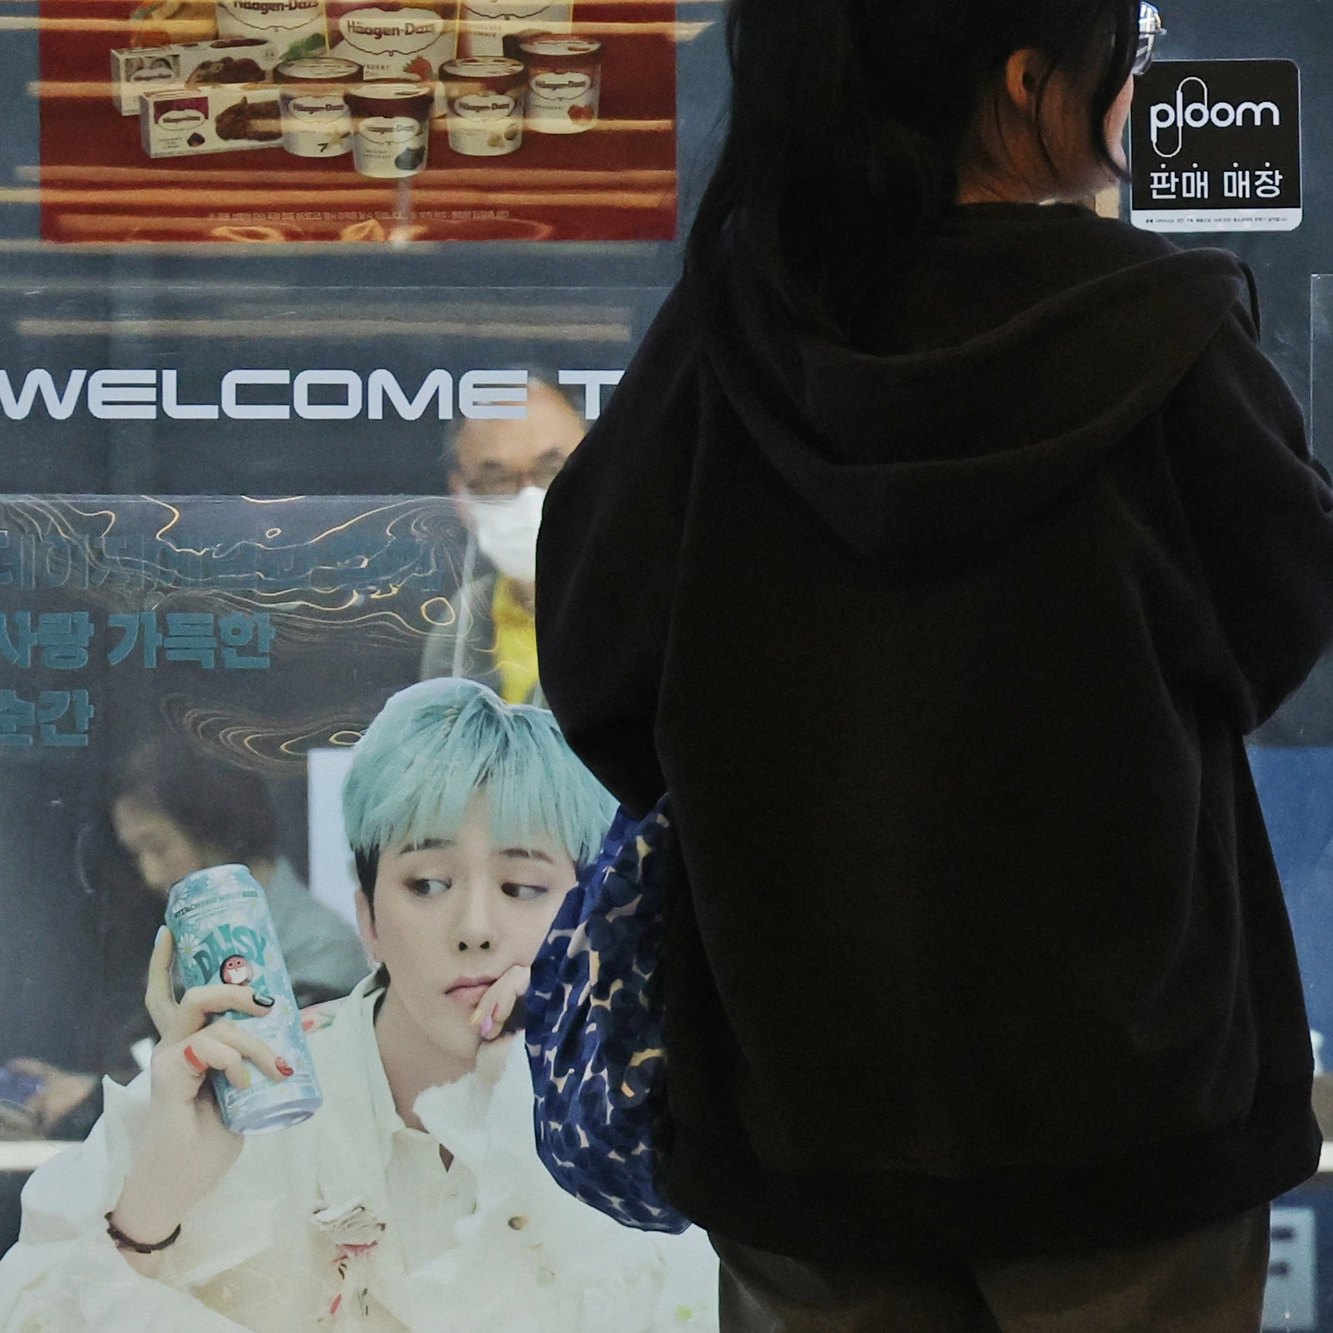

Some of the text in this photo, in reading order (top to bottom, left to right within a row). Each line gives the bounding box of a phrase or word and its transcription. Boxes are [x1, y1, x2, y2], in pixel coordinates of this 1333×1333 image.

[1150, 77, 1280, 157] ploom
[1150, 170, 1283, 200] 판매 매장
[0, 369, 528, 420] WELCOME
[107, 611, 276, 668] 가득한
